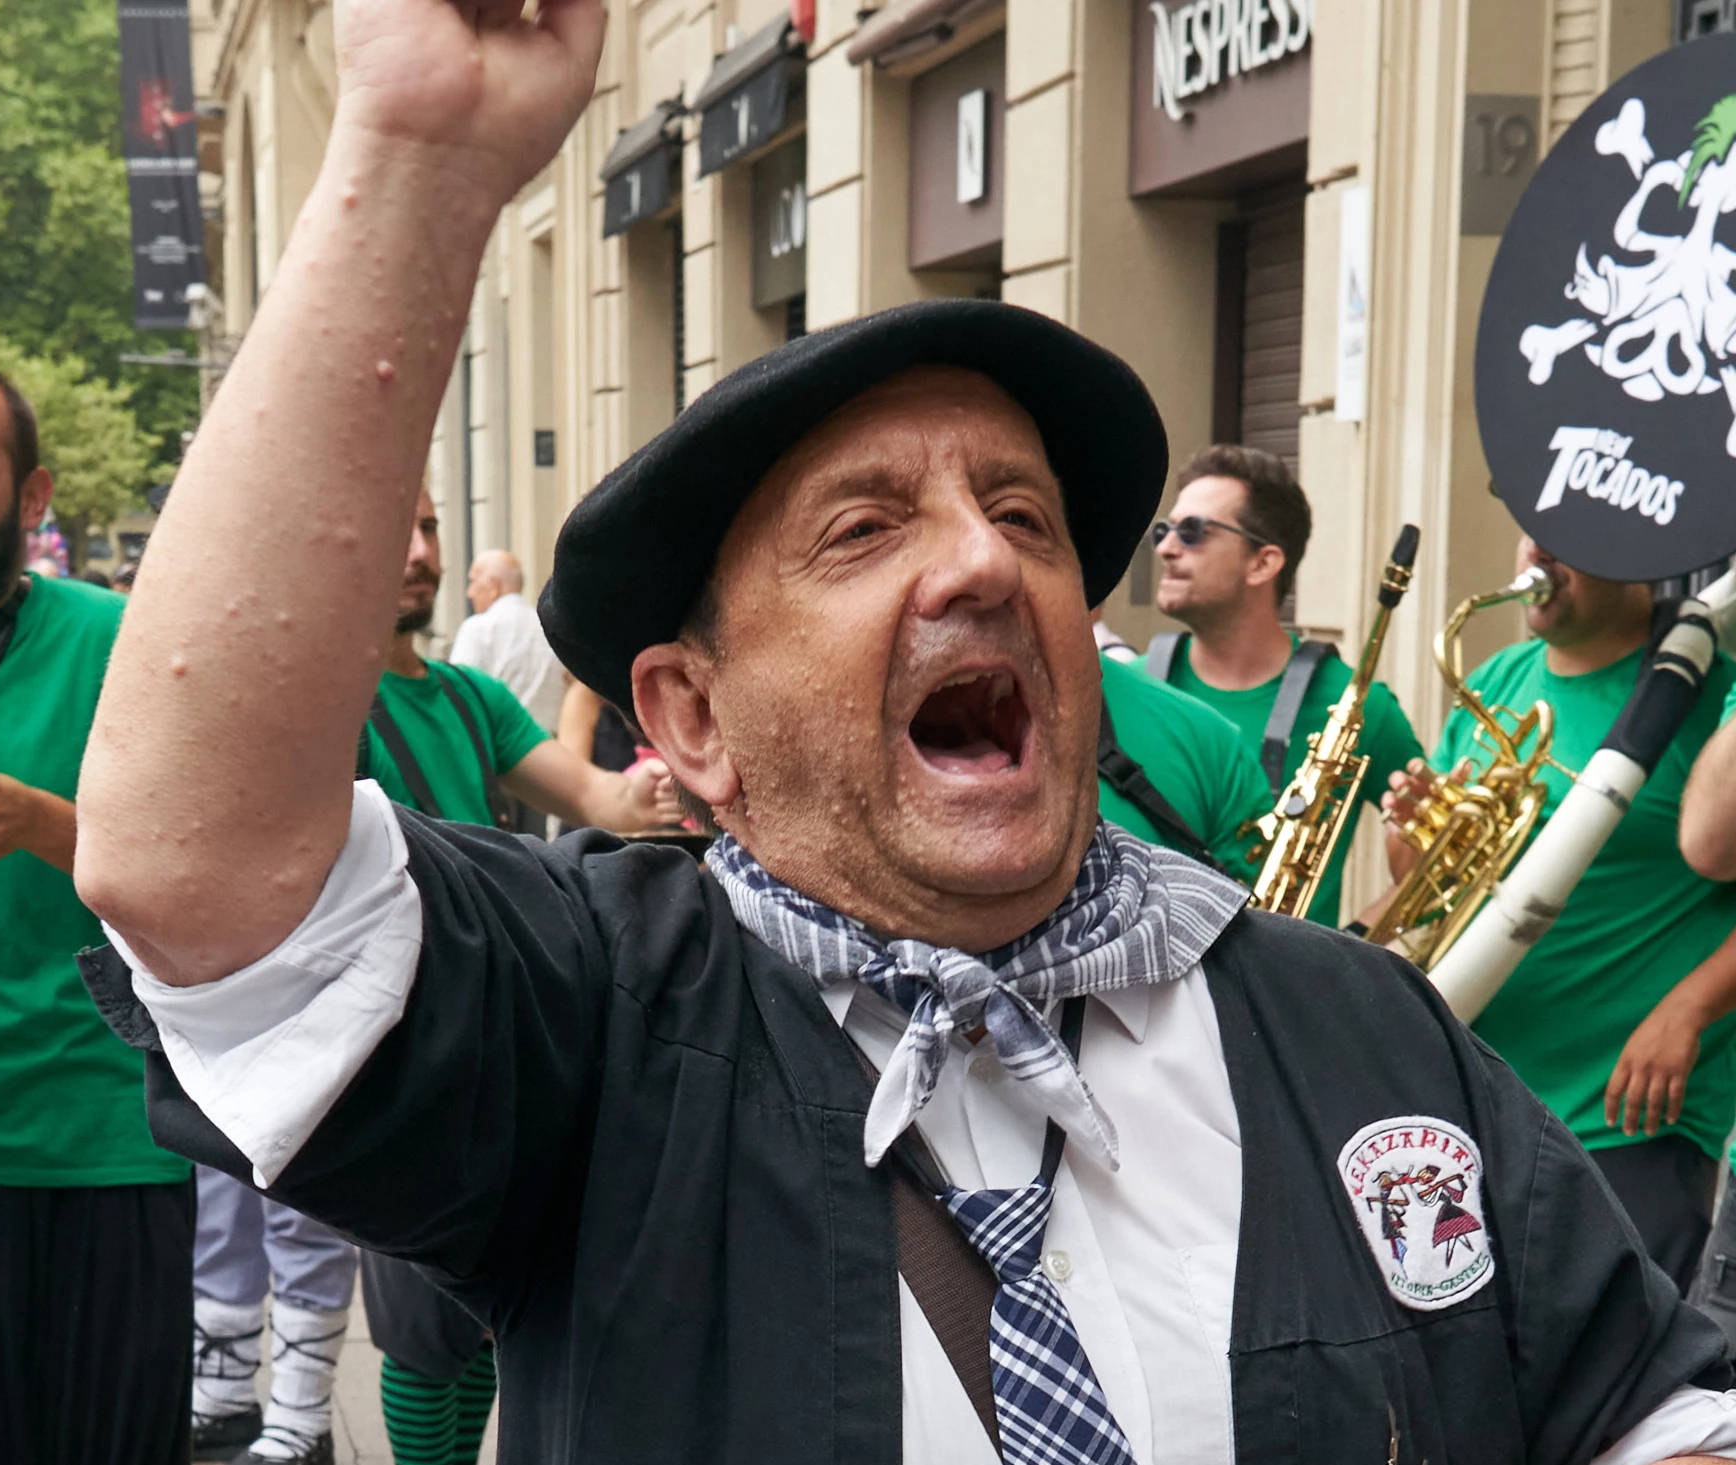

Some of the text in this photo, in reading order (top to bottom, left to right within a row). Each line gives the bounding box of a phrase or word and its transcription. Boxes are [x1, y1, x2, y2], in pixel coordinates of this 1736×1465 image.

[1150, 1, 1317, 121] NESPRESS
[1475, 112, 1538, 178] 19
[1535, 425, 1686, 526] TOCADOS
